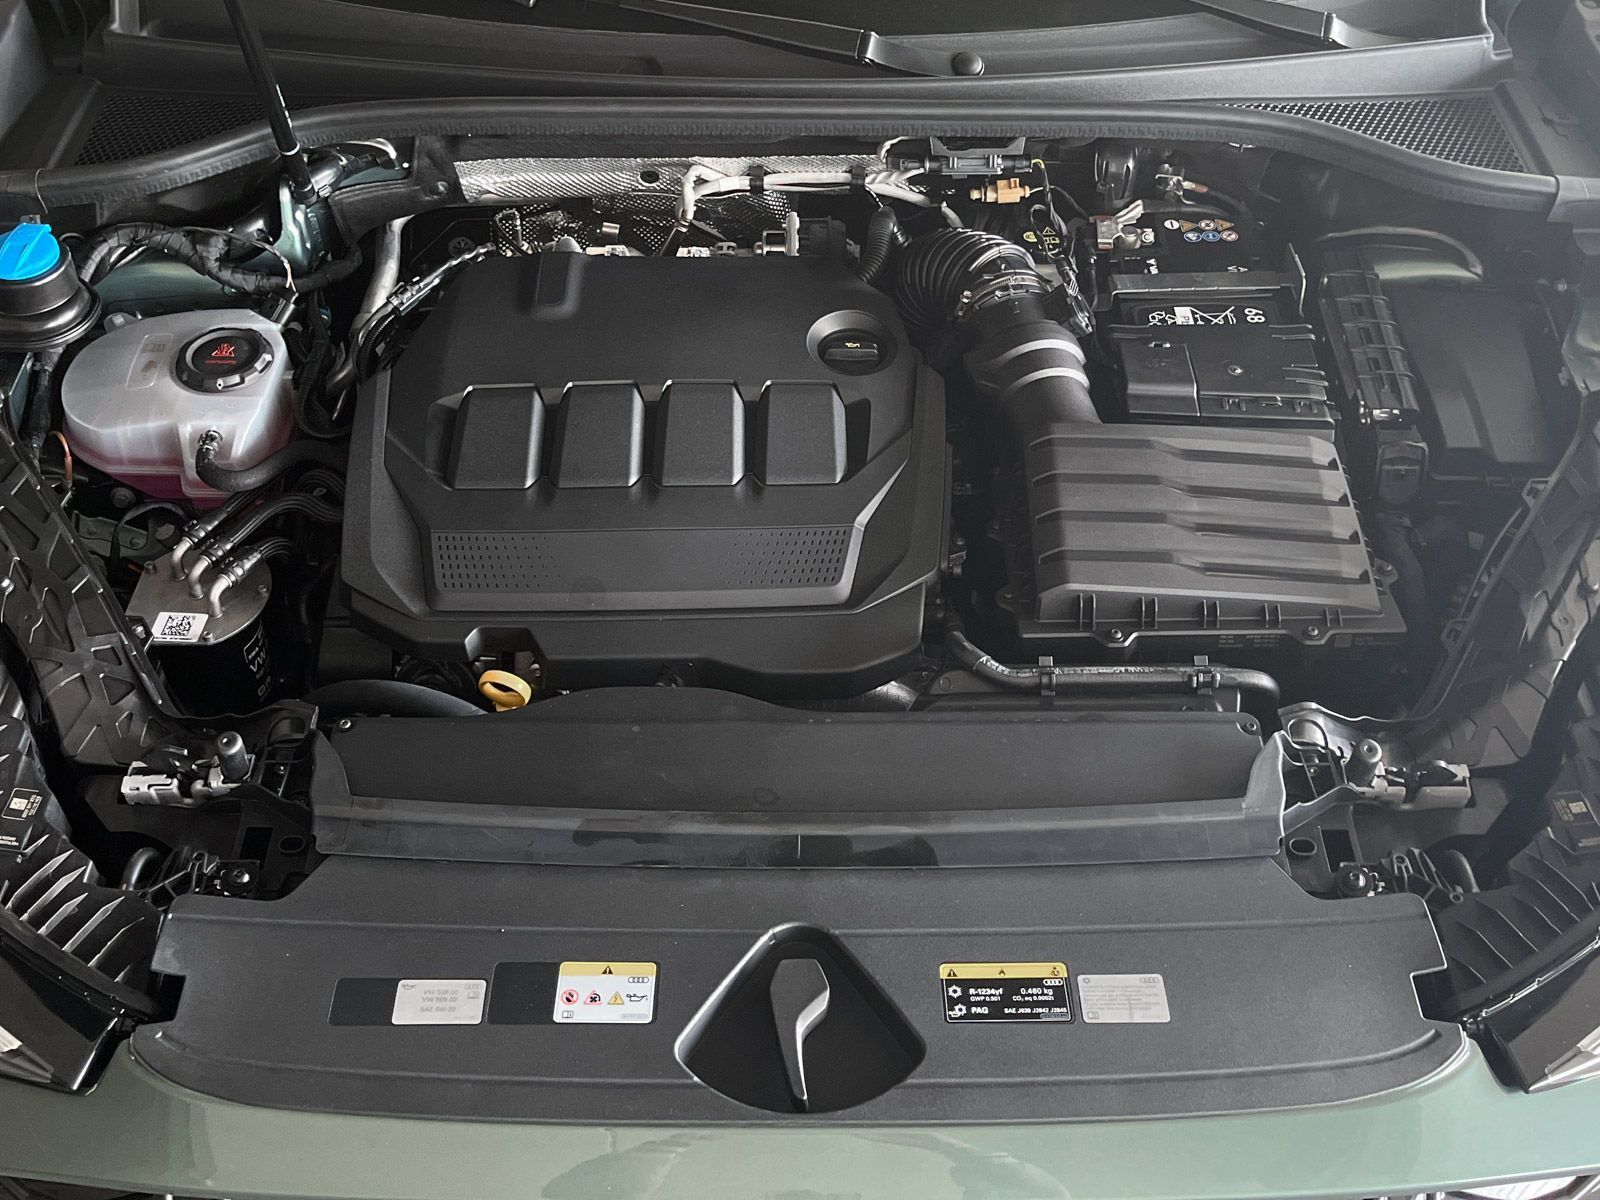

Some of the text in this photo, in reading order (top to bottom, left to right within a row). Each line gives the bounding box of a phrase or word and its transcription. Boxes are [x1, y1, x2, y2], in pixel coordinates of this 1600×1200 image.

[1244, 307, 1266, 323] 68
[969, 987, 1003, 996] R-1234yf
[1043, 987, 1054, 996] kg
[971, 1006, 989, 1014] PAG
